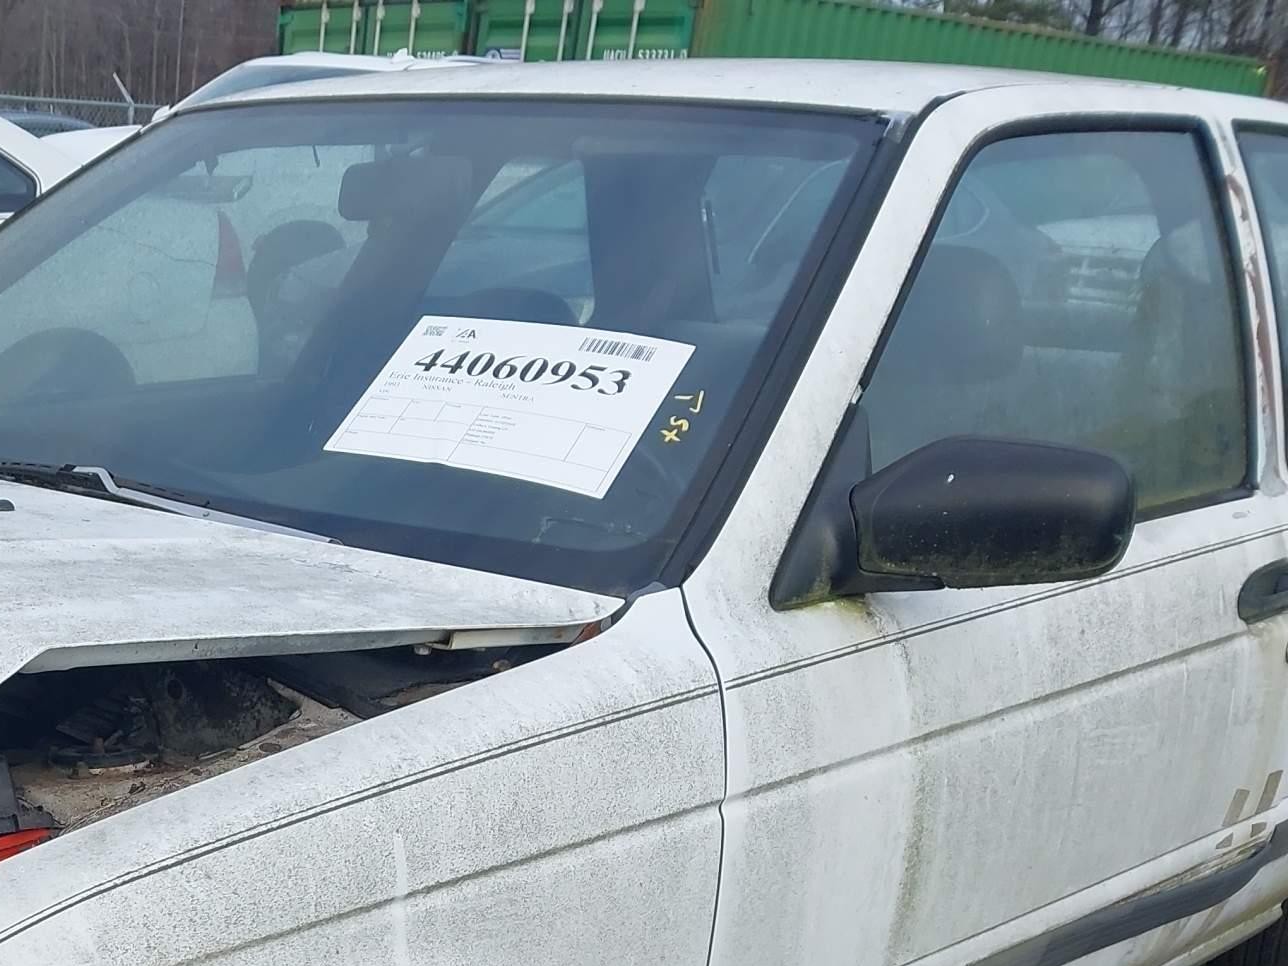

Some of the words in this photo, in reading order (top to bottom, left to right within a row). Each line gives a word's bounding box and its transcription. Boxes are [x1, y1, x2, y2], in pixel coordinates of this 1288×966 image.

[389, 371, 411, 380] Erie
[413, 372, 464, 385] Insurance
[474, 379, 516, 391] Raleigh
[413, 348, 632, 396] 44060953
